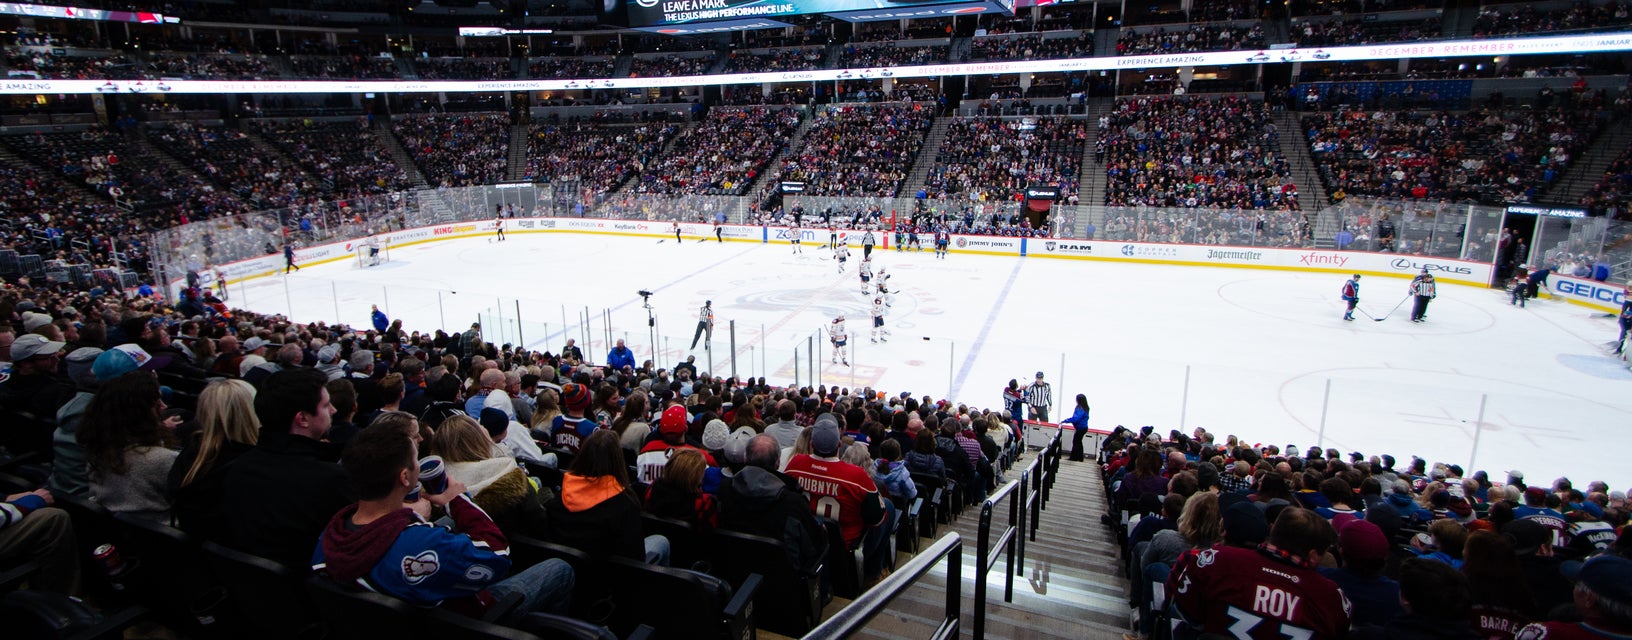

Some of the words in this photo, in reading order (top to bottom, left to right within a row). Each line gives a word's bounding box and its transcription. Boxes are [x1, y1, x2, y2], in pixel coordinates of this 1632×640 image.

[663, 1, 690, 12] LEAVE
[690, 1, 698, 10] A
[700, 0, 728, 9] MARK.
[665, 13, 677, 21] THE
[677, 12, 698, 20] LEXUS
[699, 10, 719, 18] HIGH
[719, 5, 776, 17] PERFORMANCE
[777, 4, 795, 12] LINE.
[1370, 46, 1434, 56] DECEMBER
[1443, 43, 1514, 53] REMEMBER
[918, 66, 961, 74] DECEMBER
[966, 65, 1010, 73] REMEMBER
[1117, 57, 1163, 66] EXPERIENCE
[1165, 56, 1204, 64] AMAZING
[1549, 210, 1584, 218] AMAZING
[393, 232, 427, 241] DRAFTKINGS
[434, 227, 452, 235] KING
[312, 250, 329, 260] LIGHT
[1301, 252, 1349, 267] xfinity
[1413, 262, 1471, 275] LEXUS
[798, 476, 839, 496] DUBNYK
[1253, 585, 1300, 621] ROY
